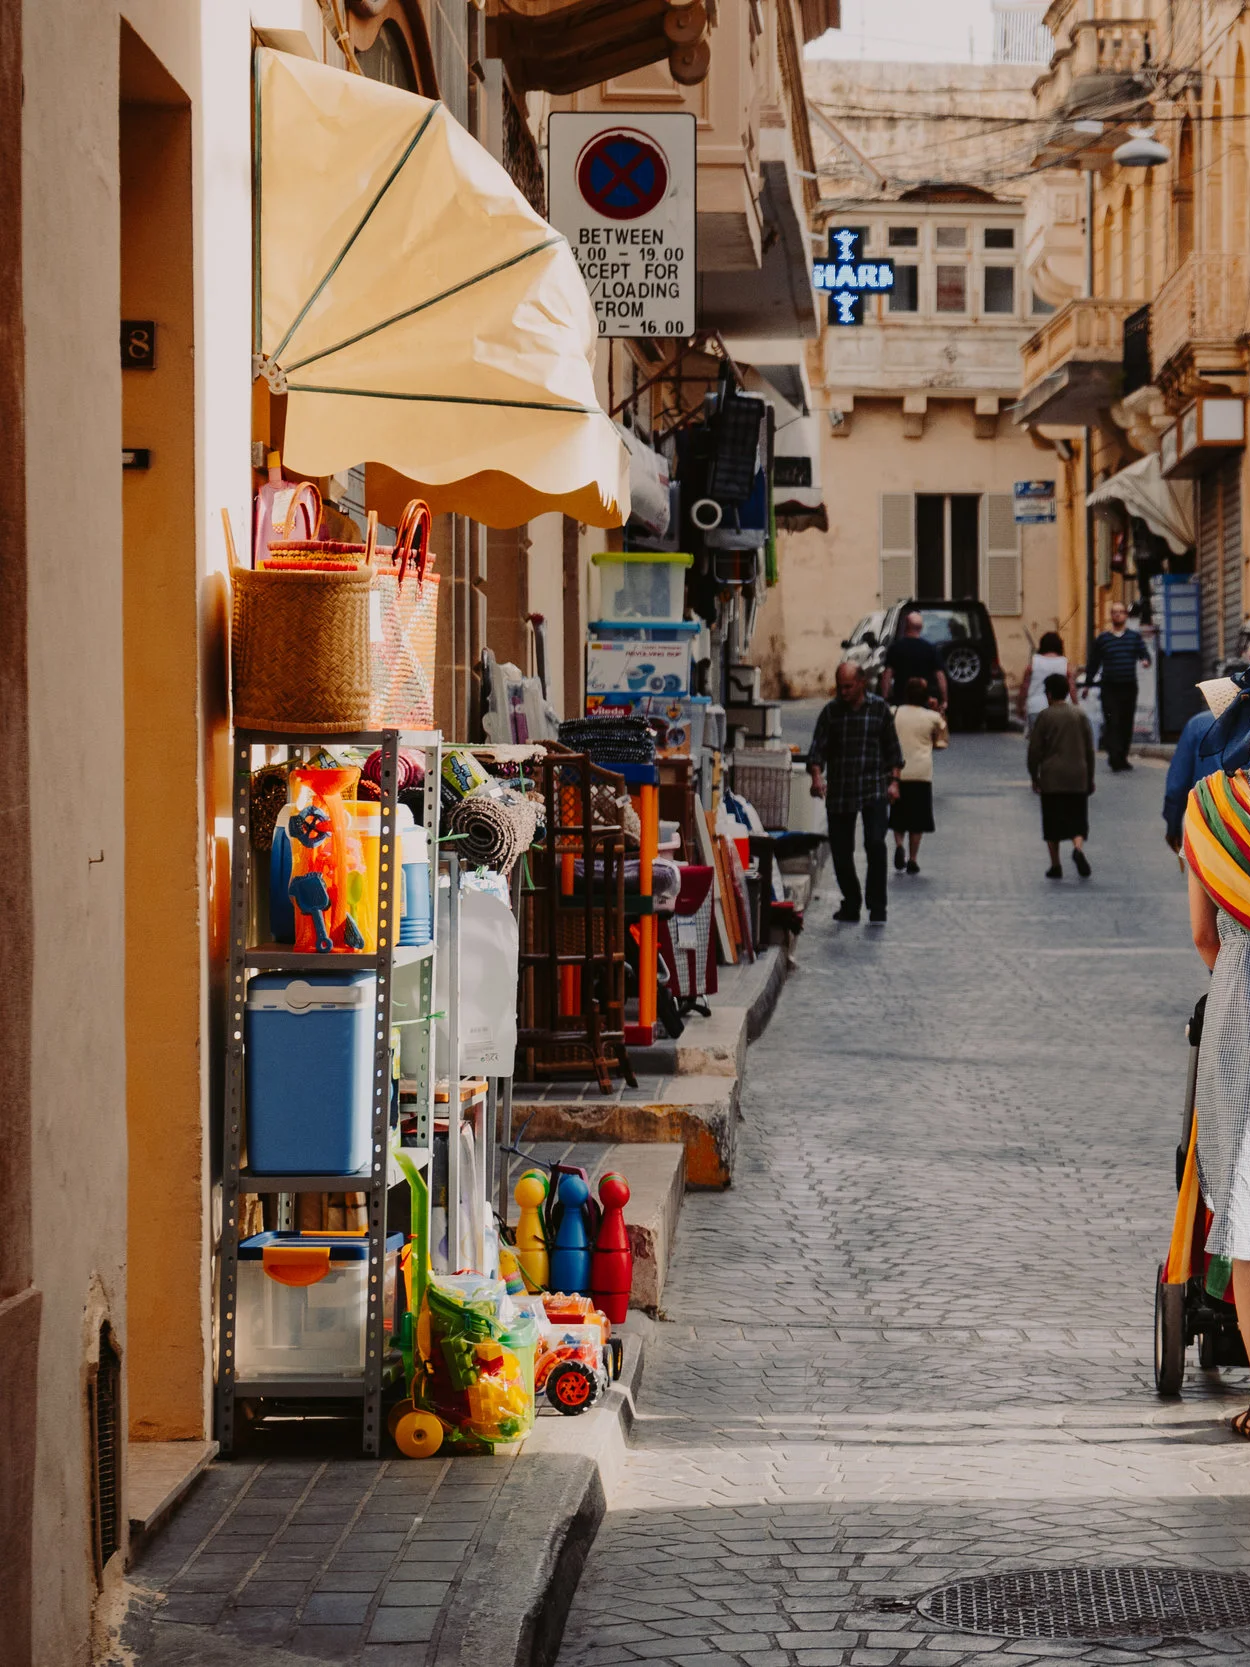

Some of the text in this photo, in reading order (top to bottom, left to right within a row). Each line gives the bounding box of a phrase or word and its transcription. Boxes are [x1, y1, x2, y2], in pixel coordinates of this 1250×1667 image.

[579, 228, 664, 245] BETWEEN
[639, 247, 684, 261] 19.00
[578, 263, 679, 279] XCEPT FOR
[639, 320, 684, 334] 16.00
[591, 706, 625, 716] vileda
